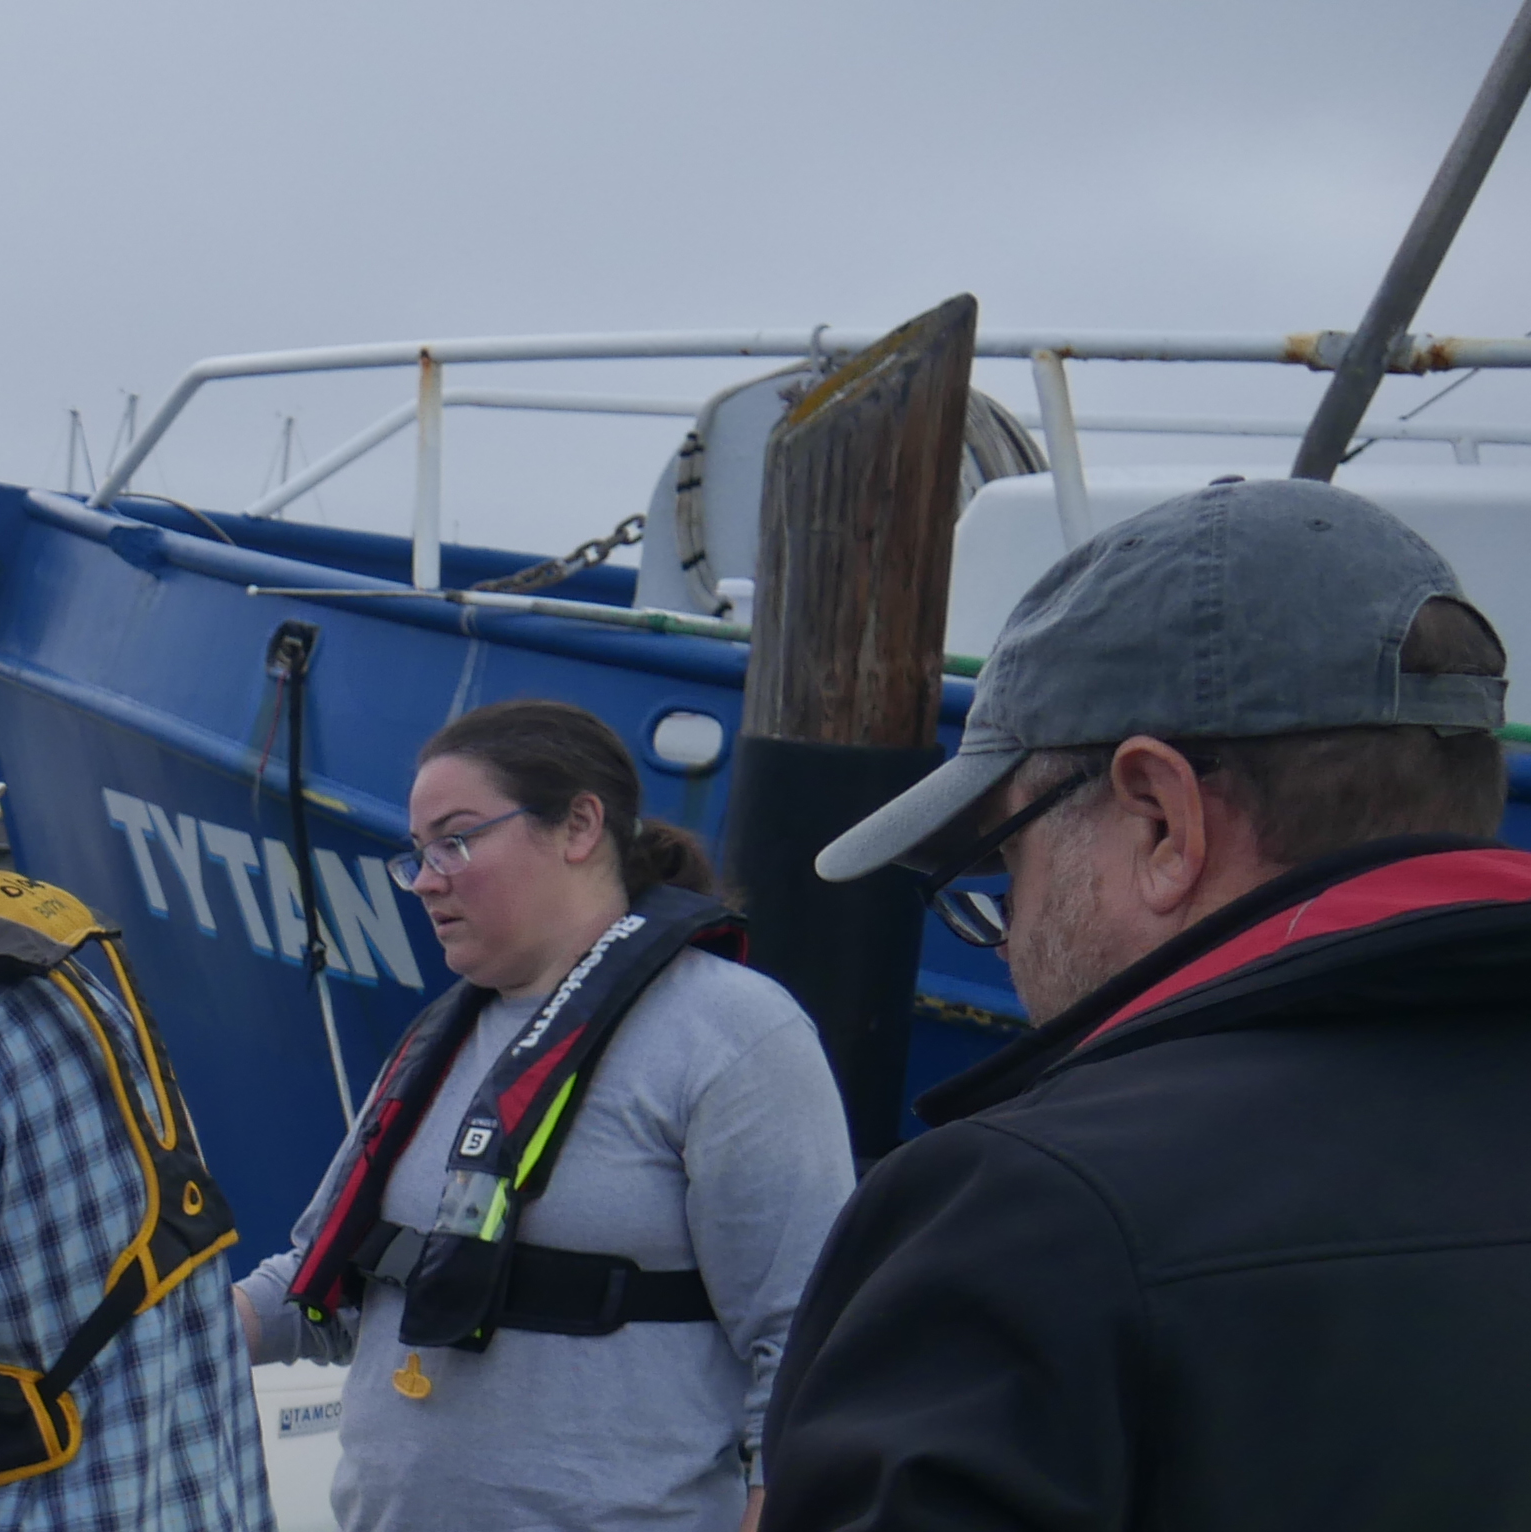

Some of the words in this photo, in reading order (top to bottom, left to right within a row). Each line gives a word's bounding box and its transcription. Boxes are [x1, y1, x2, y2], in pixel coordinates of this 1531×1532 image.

[101, 786, 426, 992] TYTAN
[515, 914, 647, 1049] Bluestorm
[294, 1401, 342, 1422] TAMCO
